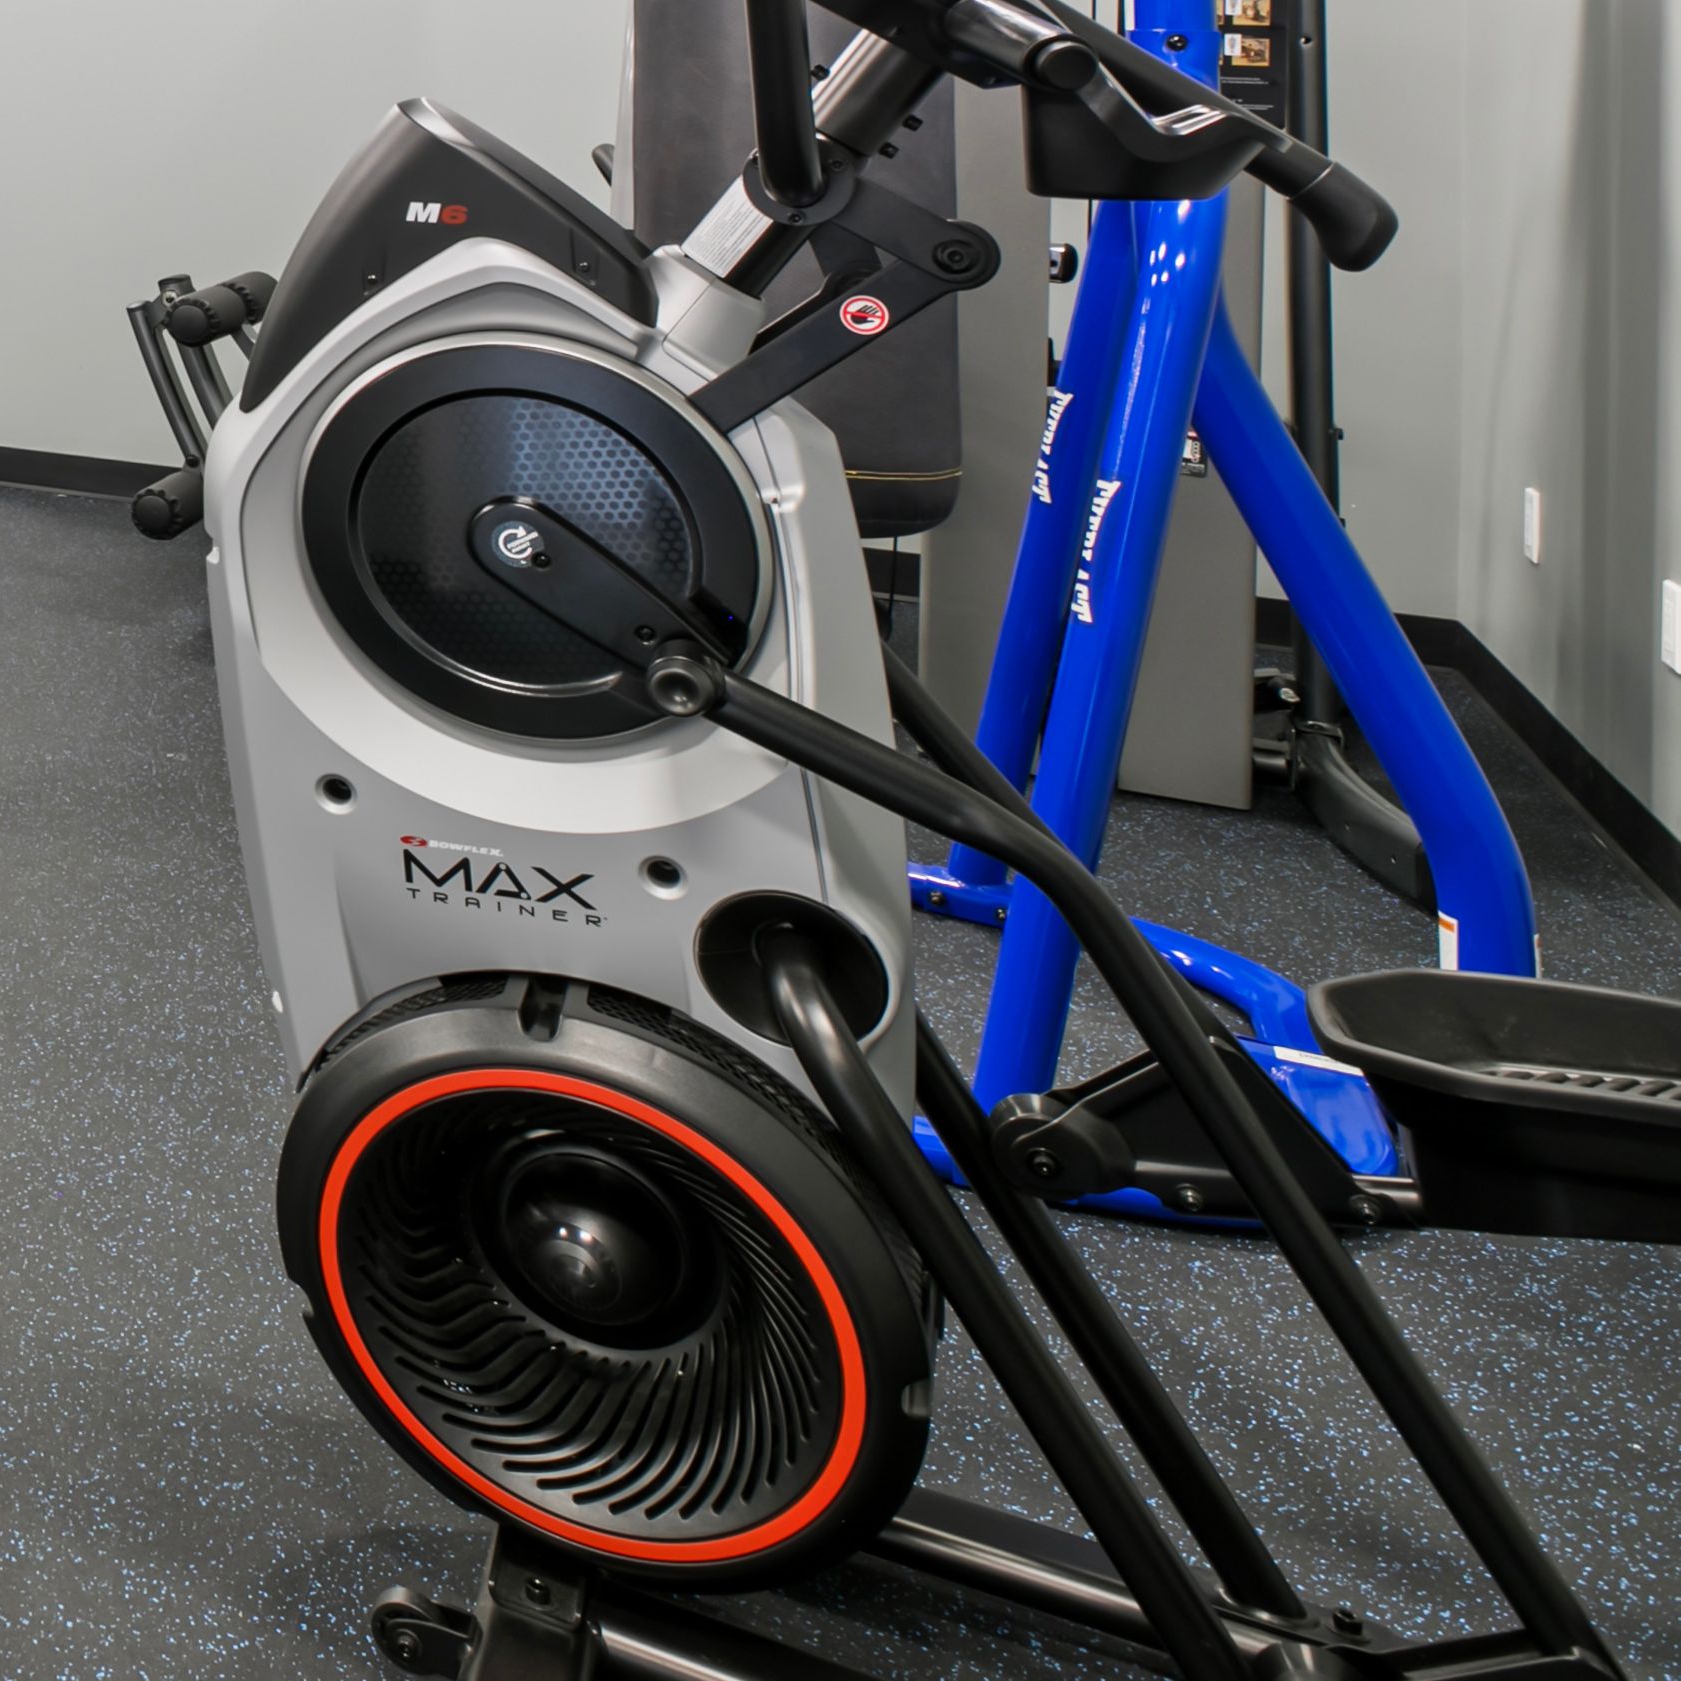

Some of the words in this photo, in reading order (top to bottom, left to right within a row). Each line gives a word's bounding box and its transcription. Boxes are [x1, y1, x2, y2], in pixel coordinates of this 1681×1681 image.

[405, 201, 469, 226] M6
[428, 839, 502, 858] BOWFLEX
[402, 848, 598, 912] MAX
[405, 887, 603, 928] TRAINER
